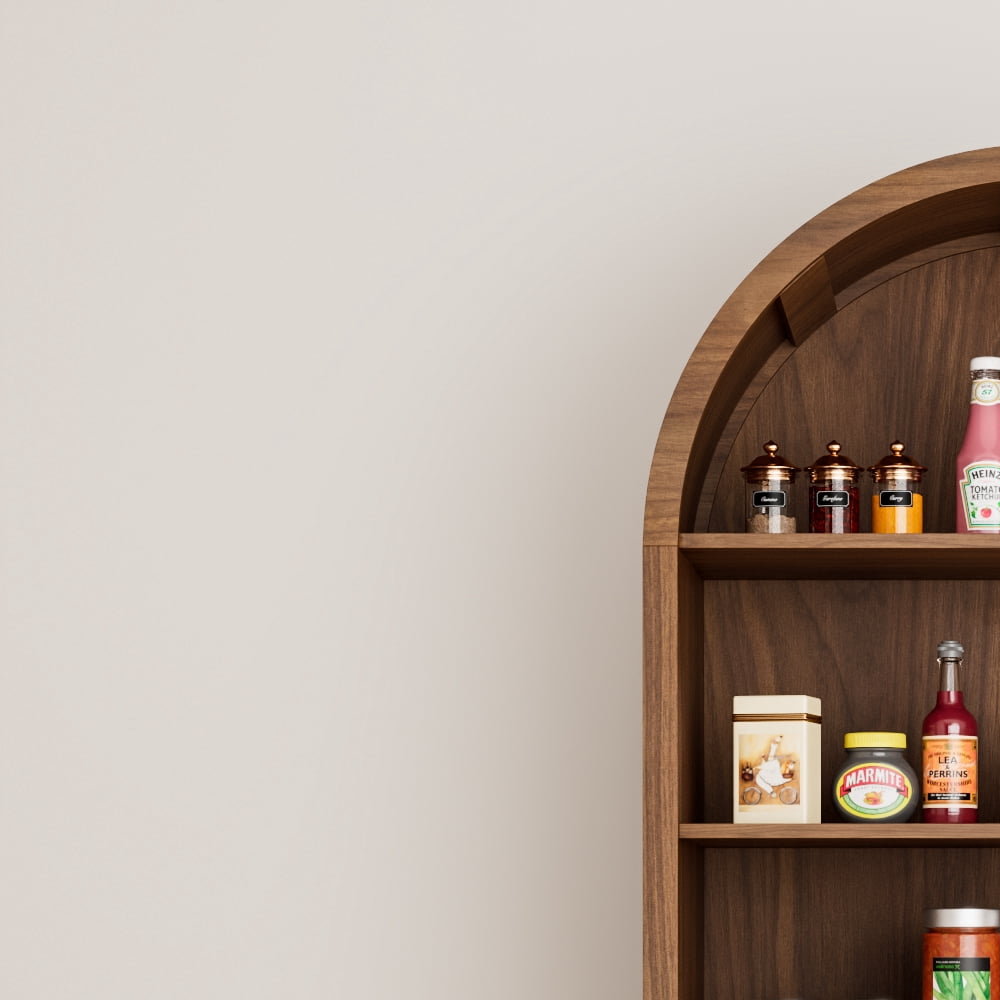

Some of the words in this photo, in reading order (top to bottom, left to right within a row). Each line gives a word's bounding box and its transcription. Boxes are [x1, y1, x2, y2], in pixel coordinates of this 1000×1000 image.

[938, 755, 958, 764] LEA
[928, 770, 969, 779] PERRINS
[845, 768, 905, 791] MARMITE
